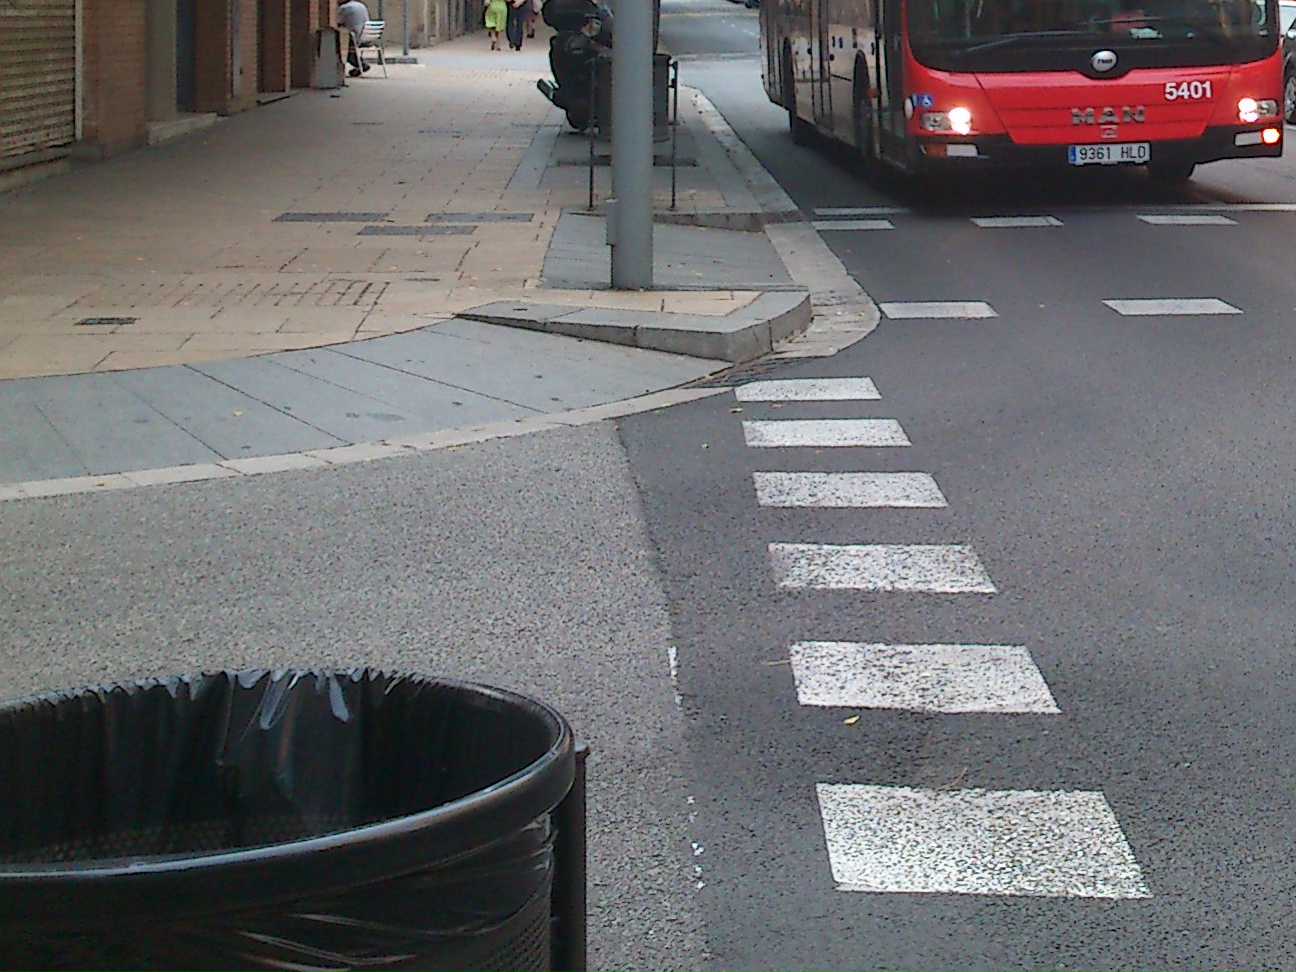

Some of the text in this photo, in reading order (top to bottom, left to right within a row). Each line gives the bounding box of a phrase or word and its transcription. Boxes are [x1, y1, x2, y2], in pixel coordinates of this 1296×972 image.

[1164, 81, 1212, 101] 5401
[1071, 106, 1146, 125] MAN
[1079, 146, 1112, 161] 9361
